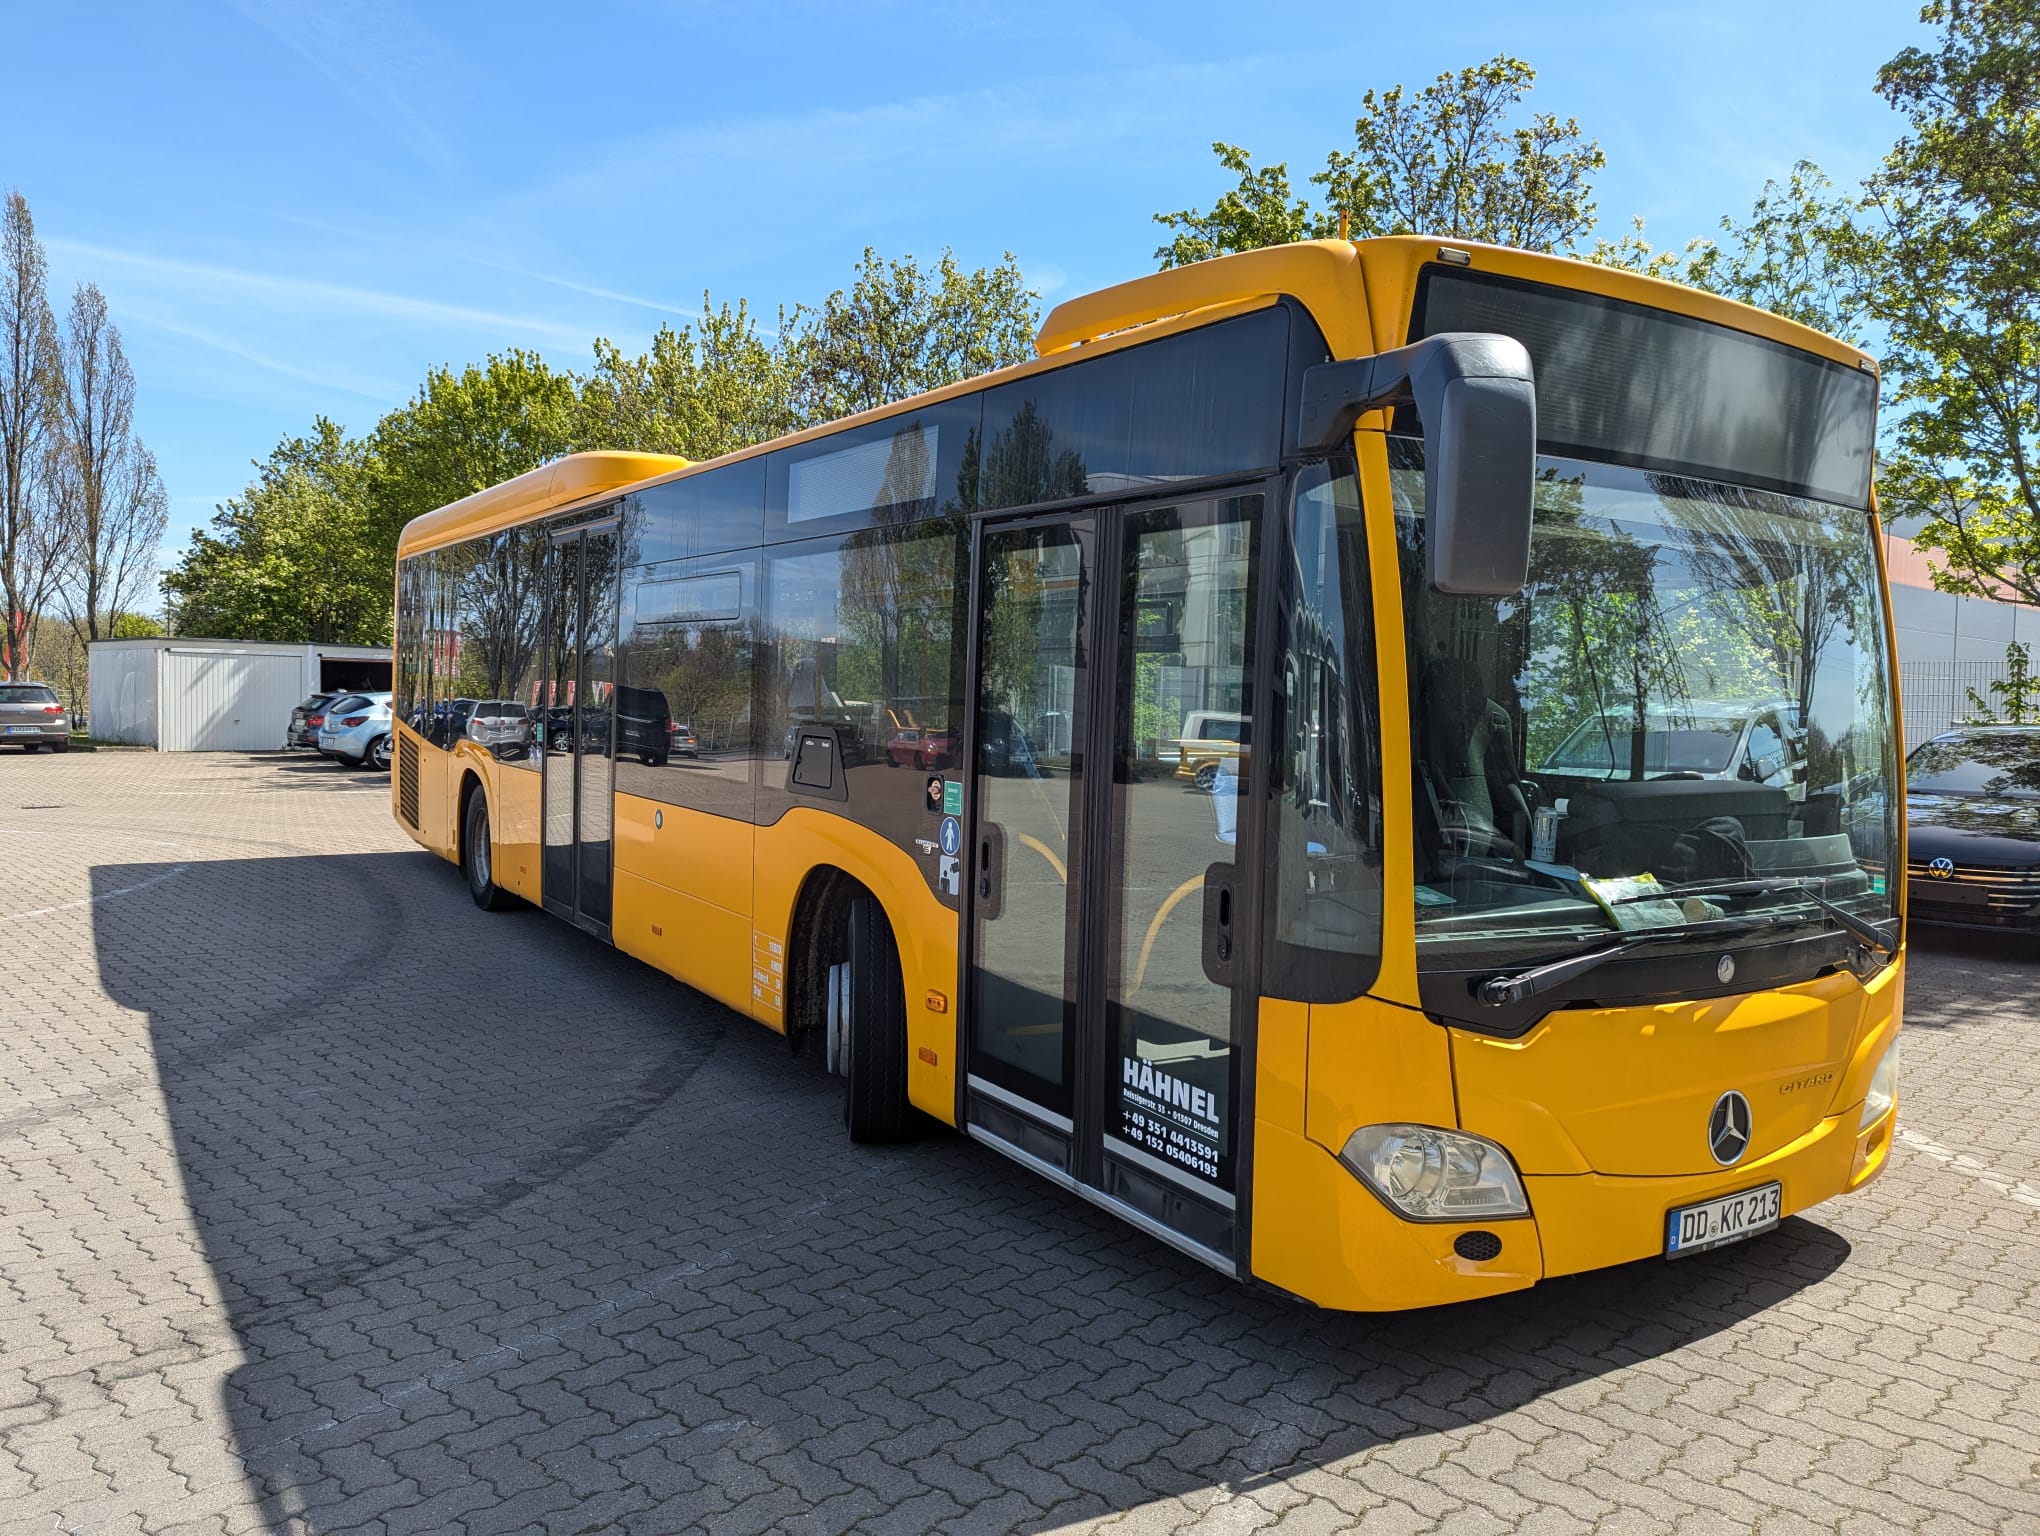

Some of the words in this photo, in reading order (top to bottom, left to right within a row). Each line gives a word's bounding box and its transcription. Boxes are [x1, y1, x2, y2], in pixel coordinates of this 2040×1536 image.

[1123, 1057, 1220, 1124] HÄHNEL
[1121, 1125, 1143, 1141] +49
[1145, 1134, 1164, 1152] 152
[1166, 1144, 1218, 1178] 05406193
[1122, 1110, 1145, 1127] +49
[1148, 1119, 1167, 1138] 351
[1170, 1130, 1219, 1163] 4413591
[1193, 1120, 1219, 1139] Dresden
[1682, 1210, 1708, 1243] DD
[1720, 1200, 1744, 1233] KR
[1747, 1189, 1779, 1225] 213
